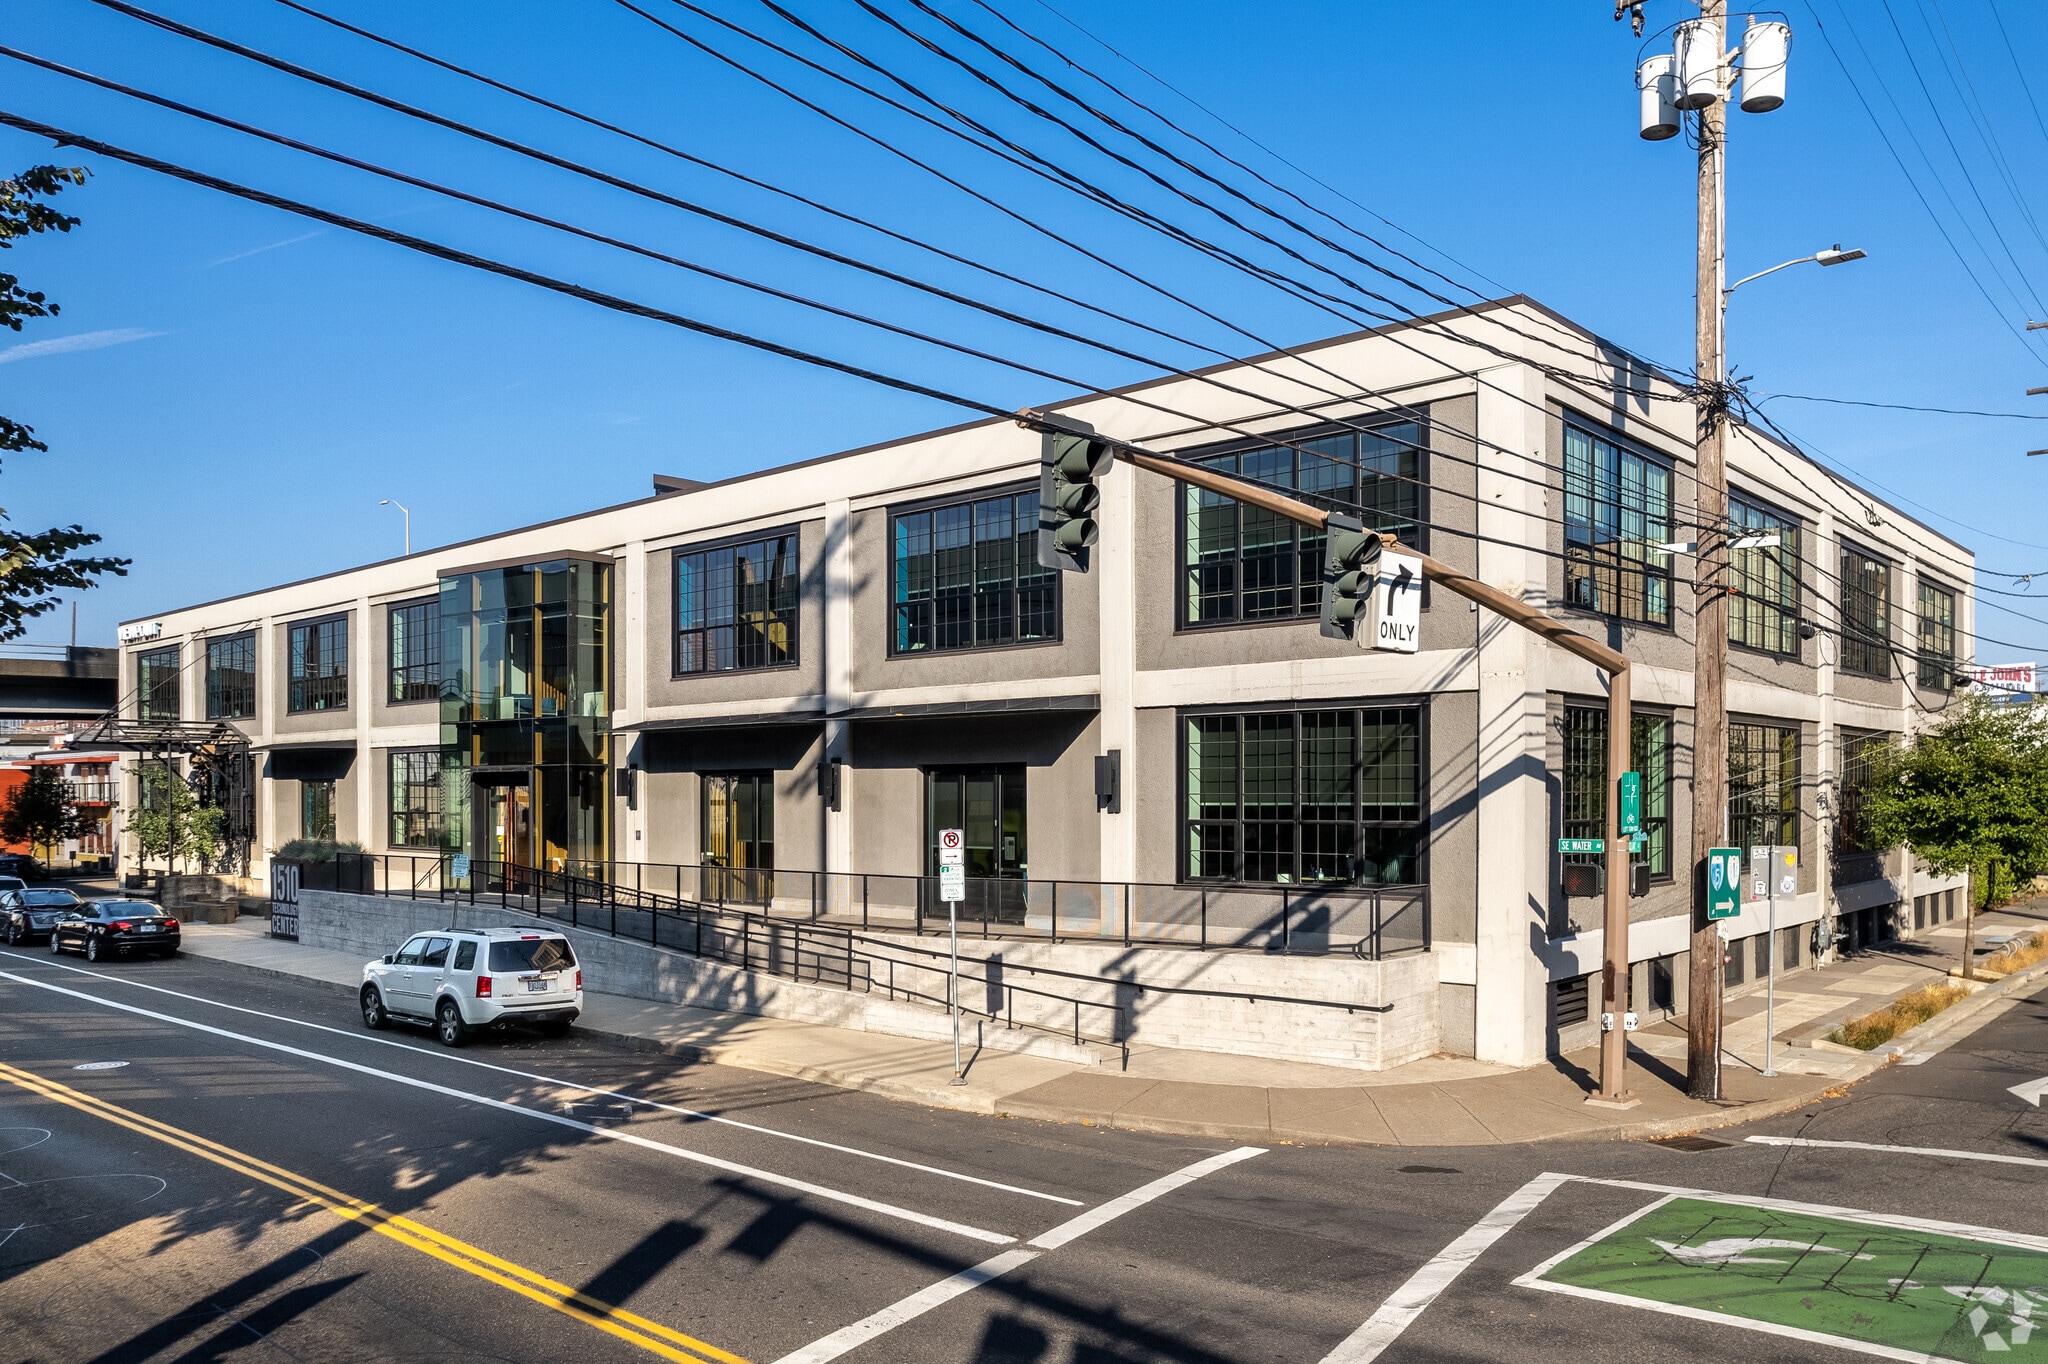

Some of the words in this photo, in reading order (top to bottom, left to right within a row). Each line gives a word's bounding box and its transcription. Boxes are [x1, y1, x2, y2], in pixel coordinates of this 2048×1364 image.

[1380, 621, 1415, 642] ONLY
[1561, 841, 1570, 850] SE
[1572, 841, 1592, 850] WATER
[271, 864, 299, 902] 1510
[1715, 868, 1720, 885] 5
[271, 915, 300, 936] CENTER
